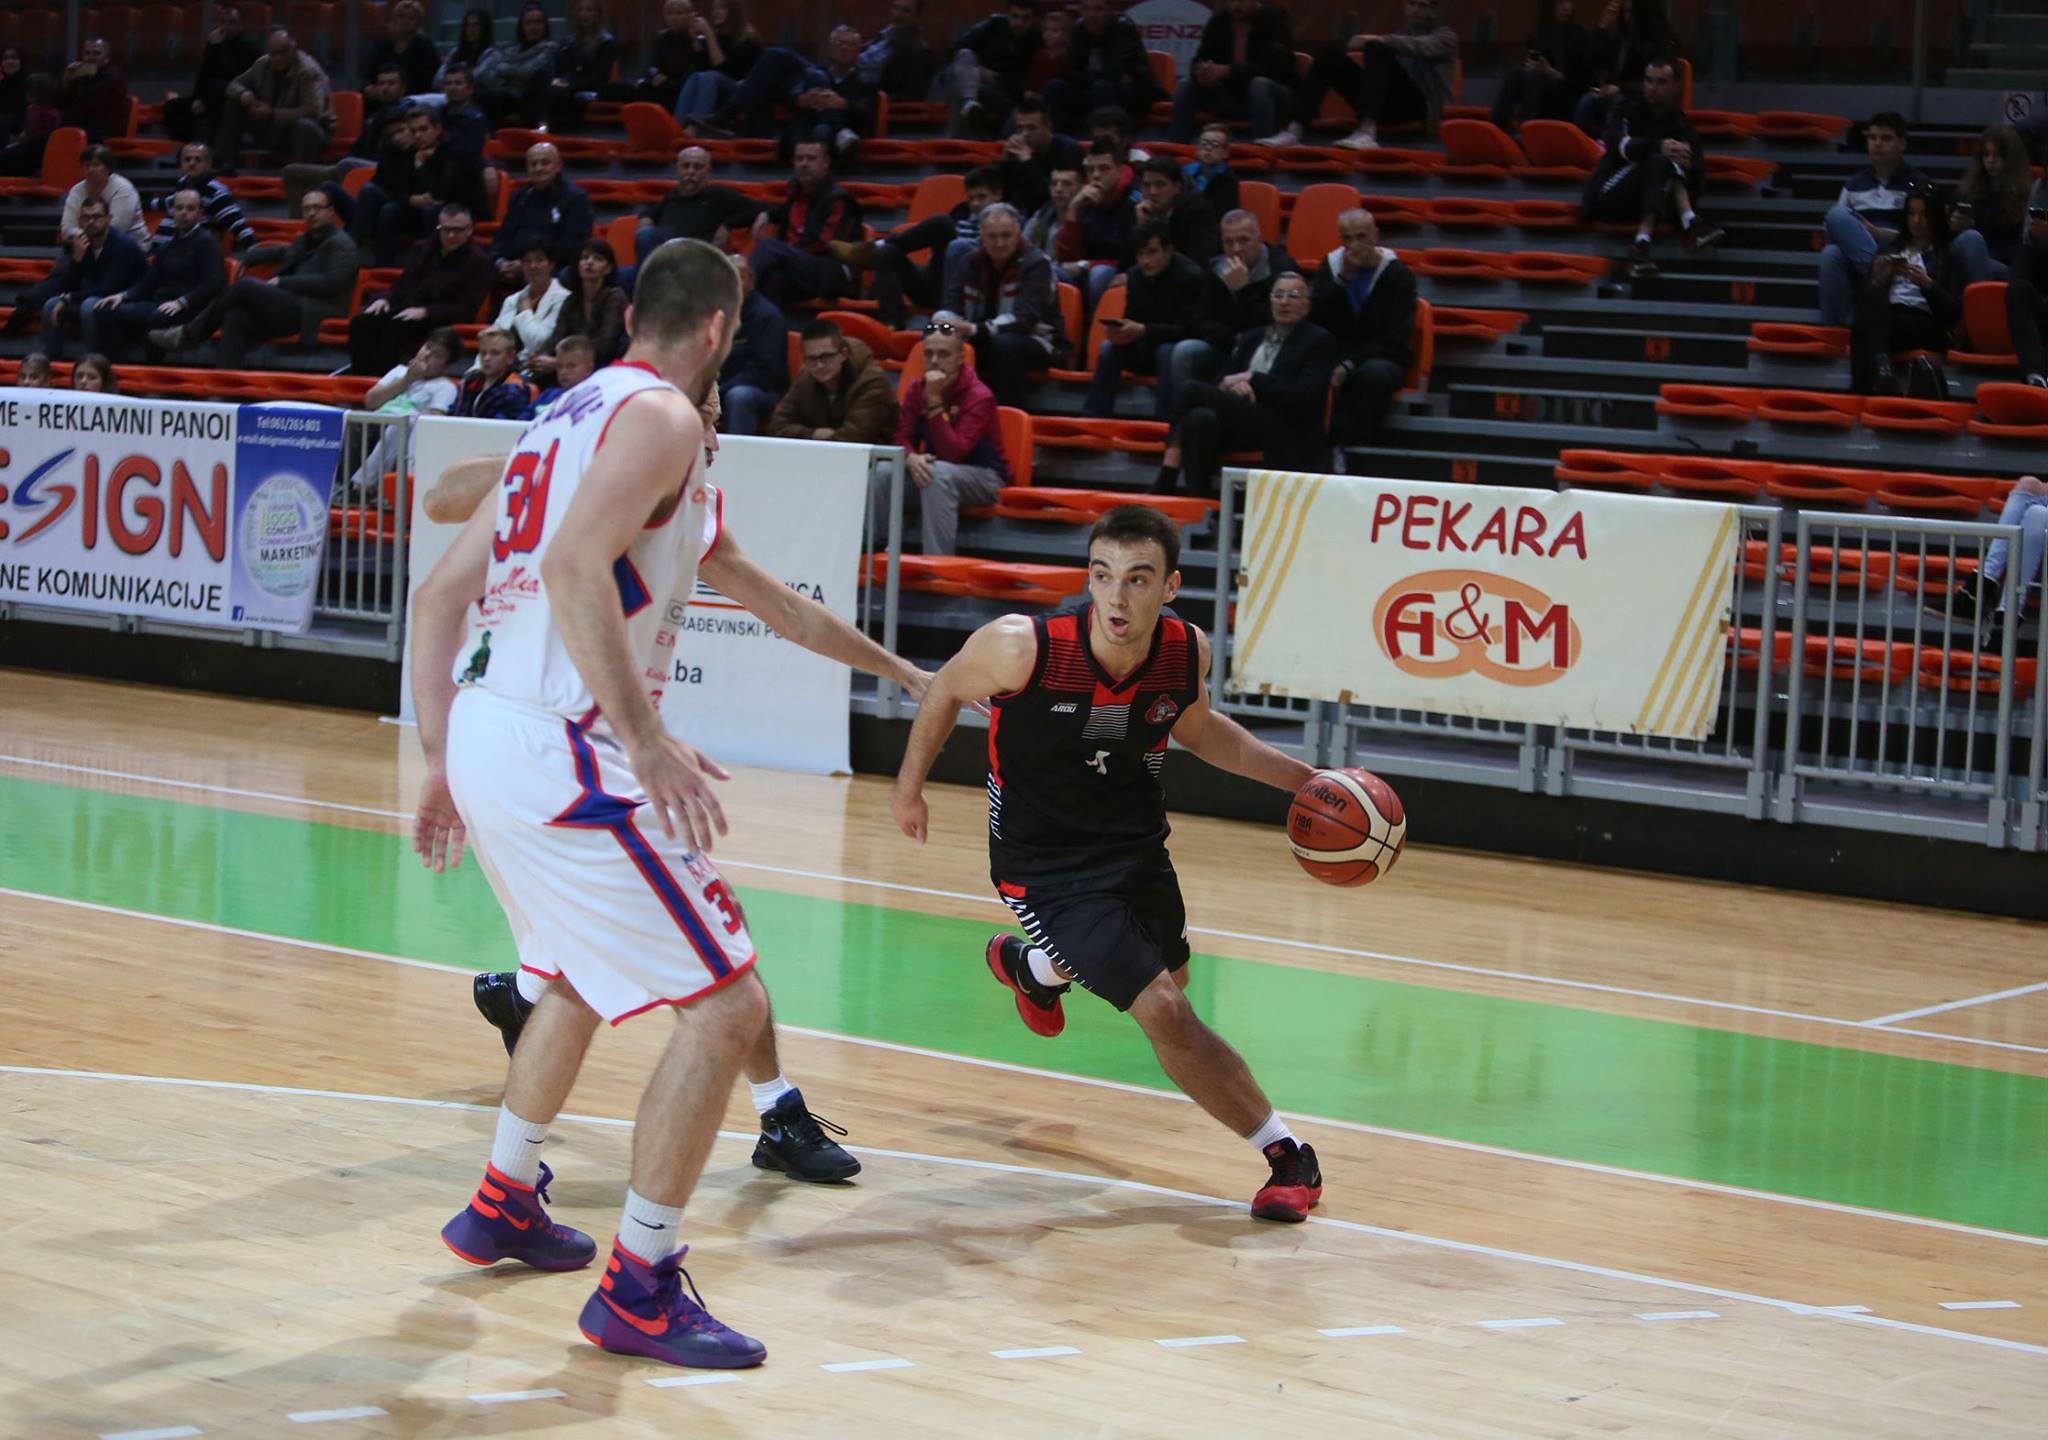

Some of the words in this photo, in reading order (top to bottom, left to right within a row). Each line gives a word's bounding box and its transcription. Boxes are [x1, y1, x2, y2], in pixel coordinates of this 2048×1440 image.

[39, 403, 152, 436] REKLAMNI
[161, 409, 231, 441] PANOI
[0, 447, 228, 563] SIGN
[1371, 493, 1587, 560] PEKARA
[38, 567, 222, 612] KOMUNIKACIJE
[681, 616, 760, 636] RAĐEVINSKI
[1385, 583, 1568, 669] A&M
